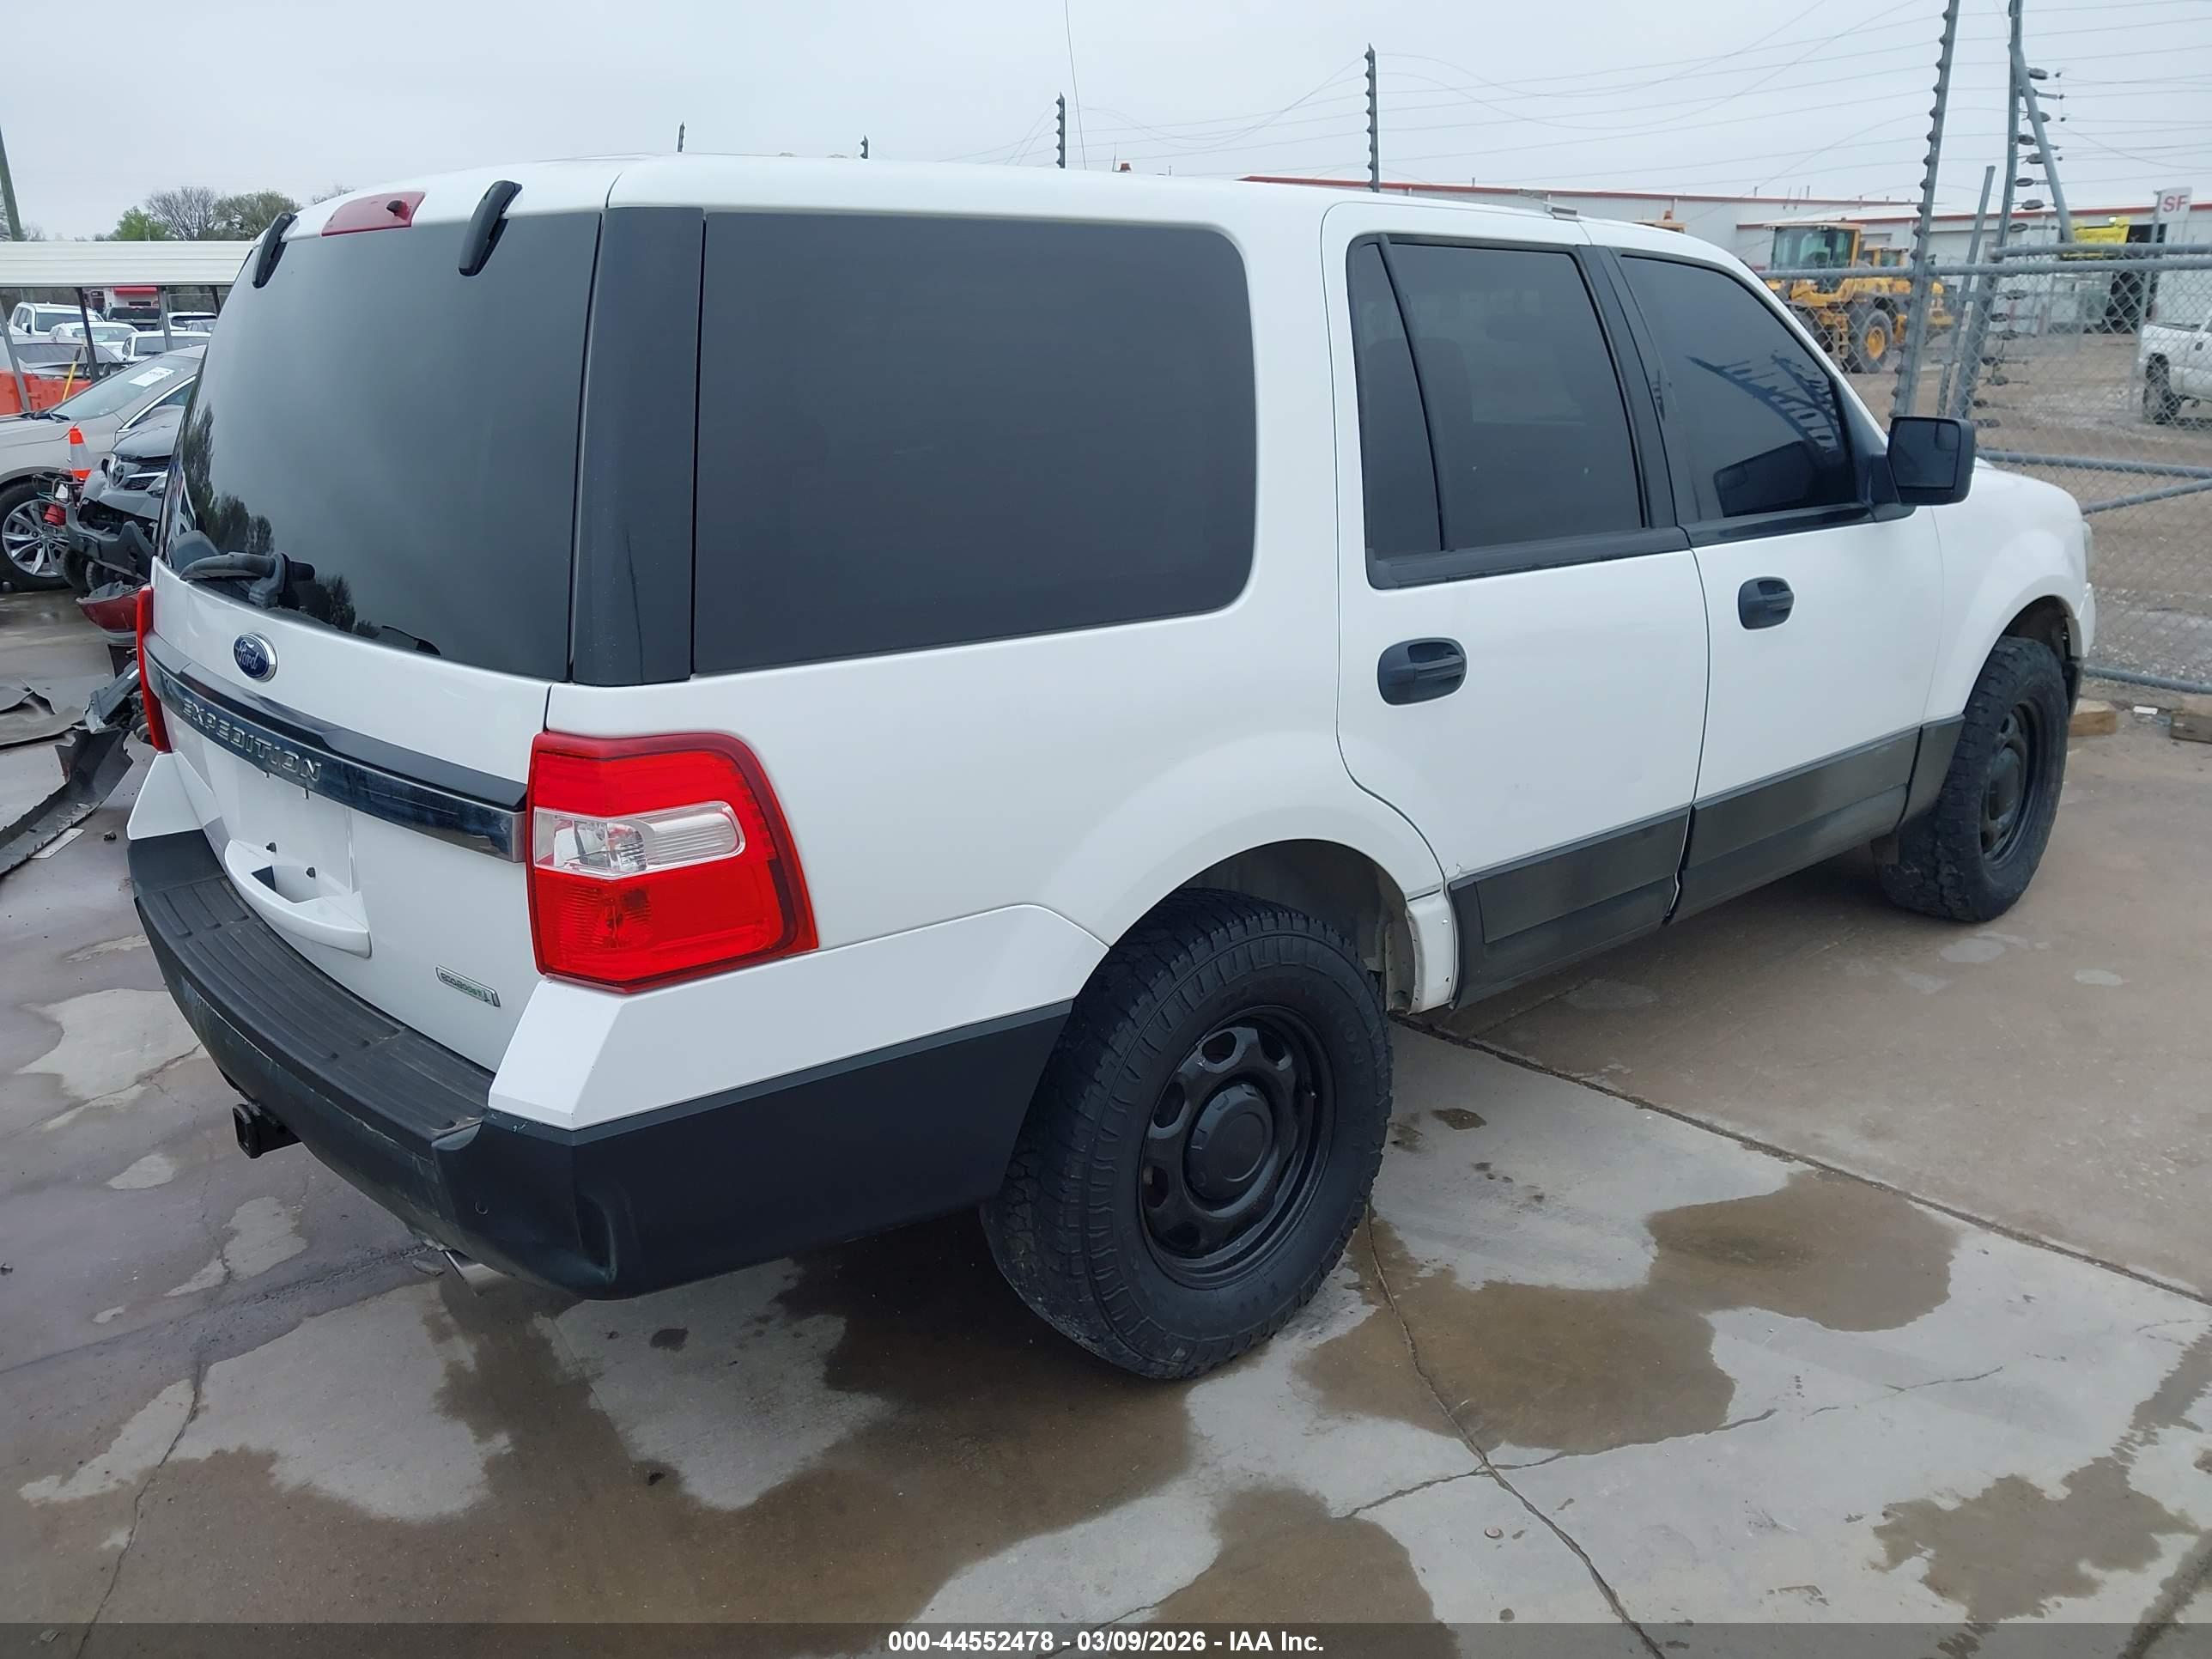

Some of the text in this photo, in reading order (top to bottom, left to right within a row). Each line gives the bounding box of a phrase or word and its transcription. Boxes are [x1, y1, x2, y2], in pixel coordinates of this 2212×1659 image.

[2162, 195, 2188, 213] SF
[235, 639, 259, 670] Ford
[182, 697, 322, 782] EXPEDITION
